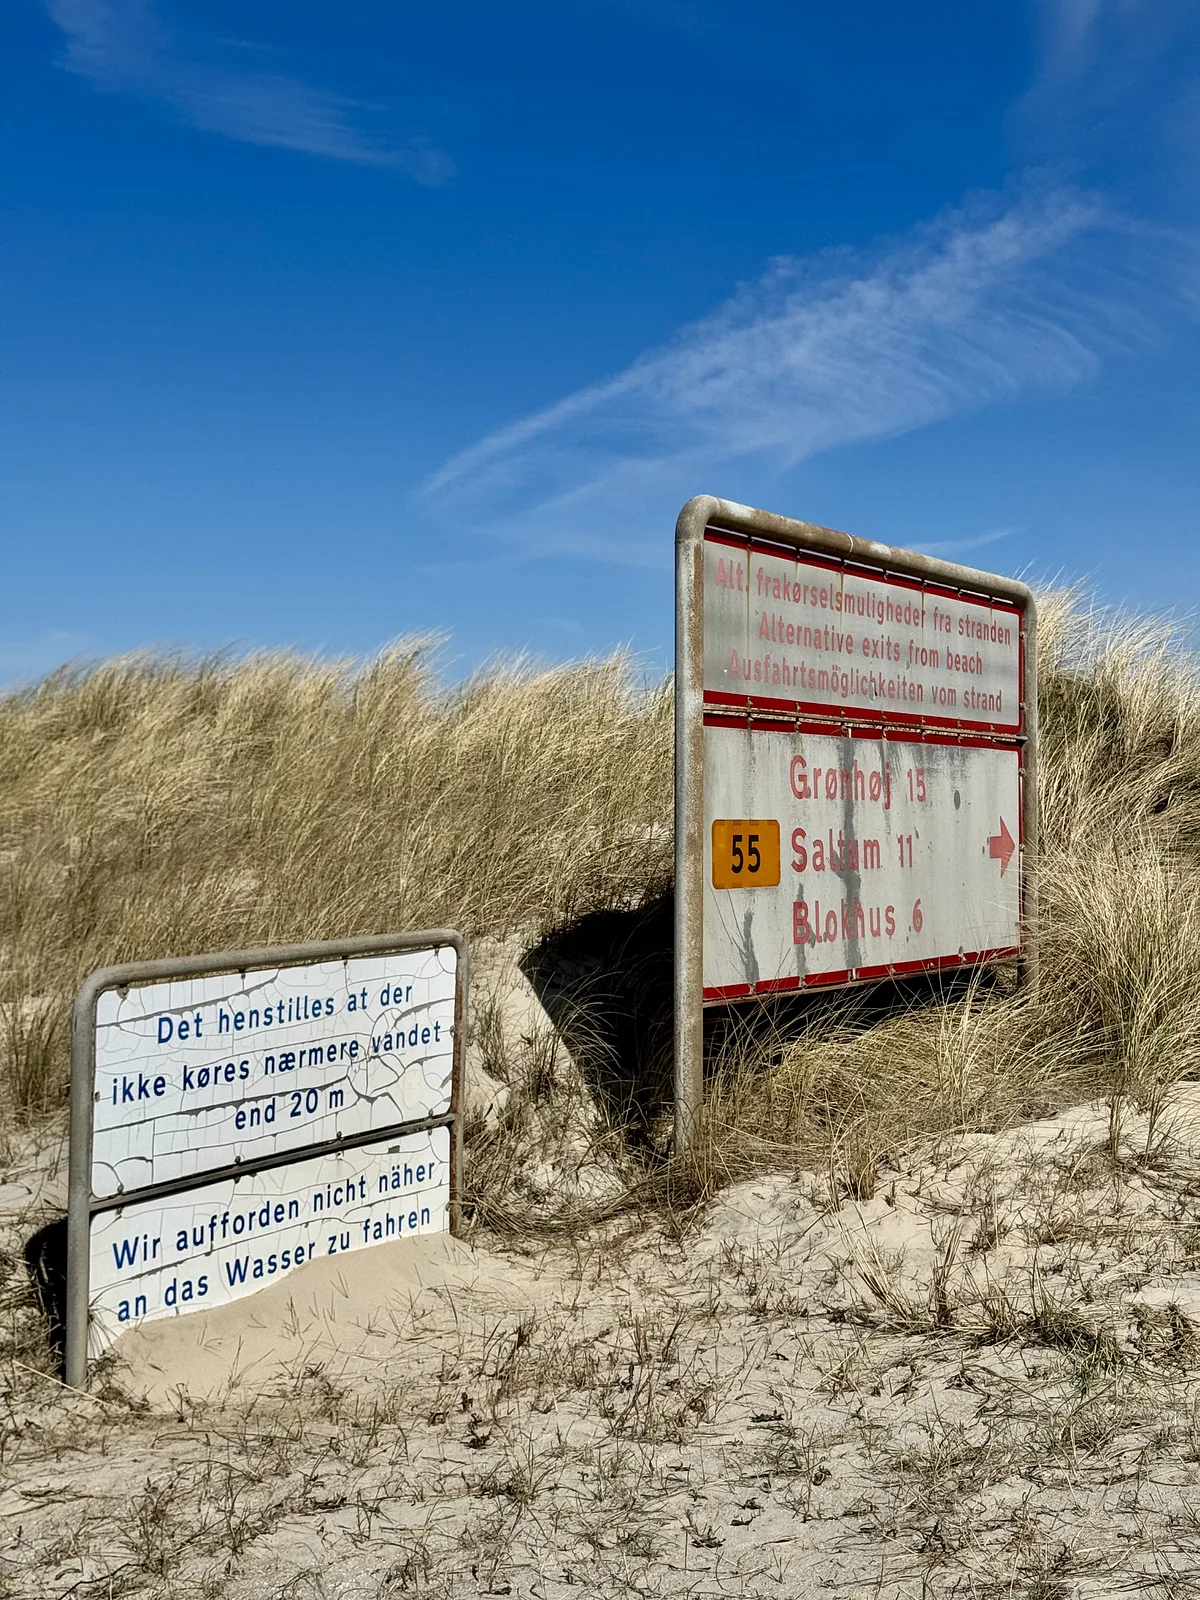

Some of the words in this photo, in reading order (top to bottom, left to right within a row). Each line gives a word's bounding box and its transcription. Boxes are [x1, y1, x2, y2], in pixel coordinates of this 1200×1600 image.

[715, 558, 749, 592] Alt.
[756, 568, 926, 628] frakørselsmuligheder
[933, 607, 951, 633] fra
[958, 617, 1011, 645] stranden
[758, 611, 854, 654] Alternative
[862, 633, 901, 661] exits
[909, 640, 939, 668] from
[946, 647, 983, 675] beach
[931, 685, 957, 706] vom
[964, 691, 1002, 712] strand
[789, 755, 891, 810] Grønhøj
[907, 769, 926, 801] 15
[731, 834, 761, 873] 55
[791, 828, 880, 872] Saltum
[898, 835, 913, 868] 11
[793, 899, 895, 944] Blokhus
[913, 898, 923, 933] 6
[157, 1014, 203, 1044] Det
[219, 995, 335, 1033] henstilles
[347, 991, 368, 1012] at
[380, 983, 413, 1006] der
[112, 1073, 166, 1105] ikke
[183, 1058, 249, 1091] køres
[264, 1041, 359, 1076] nærmere
[372, 1021, 441, 1053] vandet
[235, 1099, 275, 1130] end
[290, 1088, 319, 1118] 20
[328, 1086, 345, 1108] m
[112, 1235, 161, 1270] Wir
[176, 1198, 300, 1252] aufforden
[313, 1180, 366, 1213] nicht
[378, 1161, 435, 1194] näher
[117, 1295, 147, 1322] an
[164, 1273, 209, 1307] das
[225, 1239, 316, 1287] Wasser
[328, 1230, 351, 1255] zu
[364, 1206, 431, 1240] fahren
